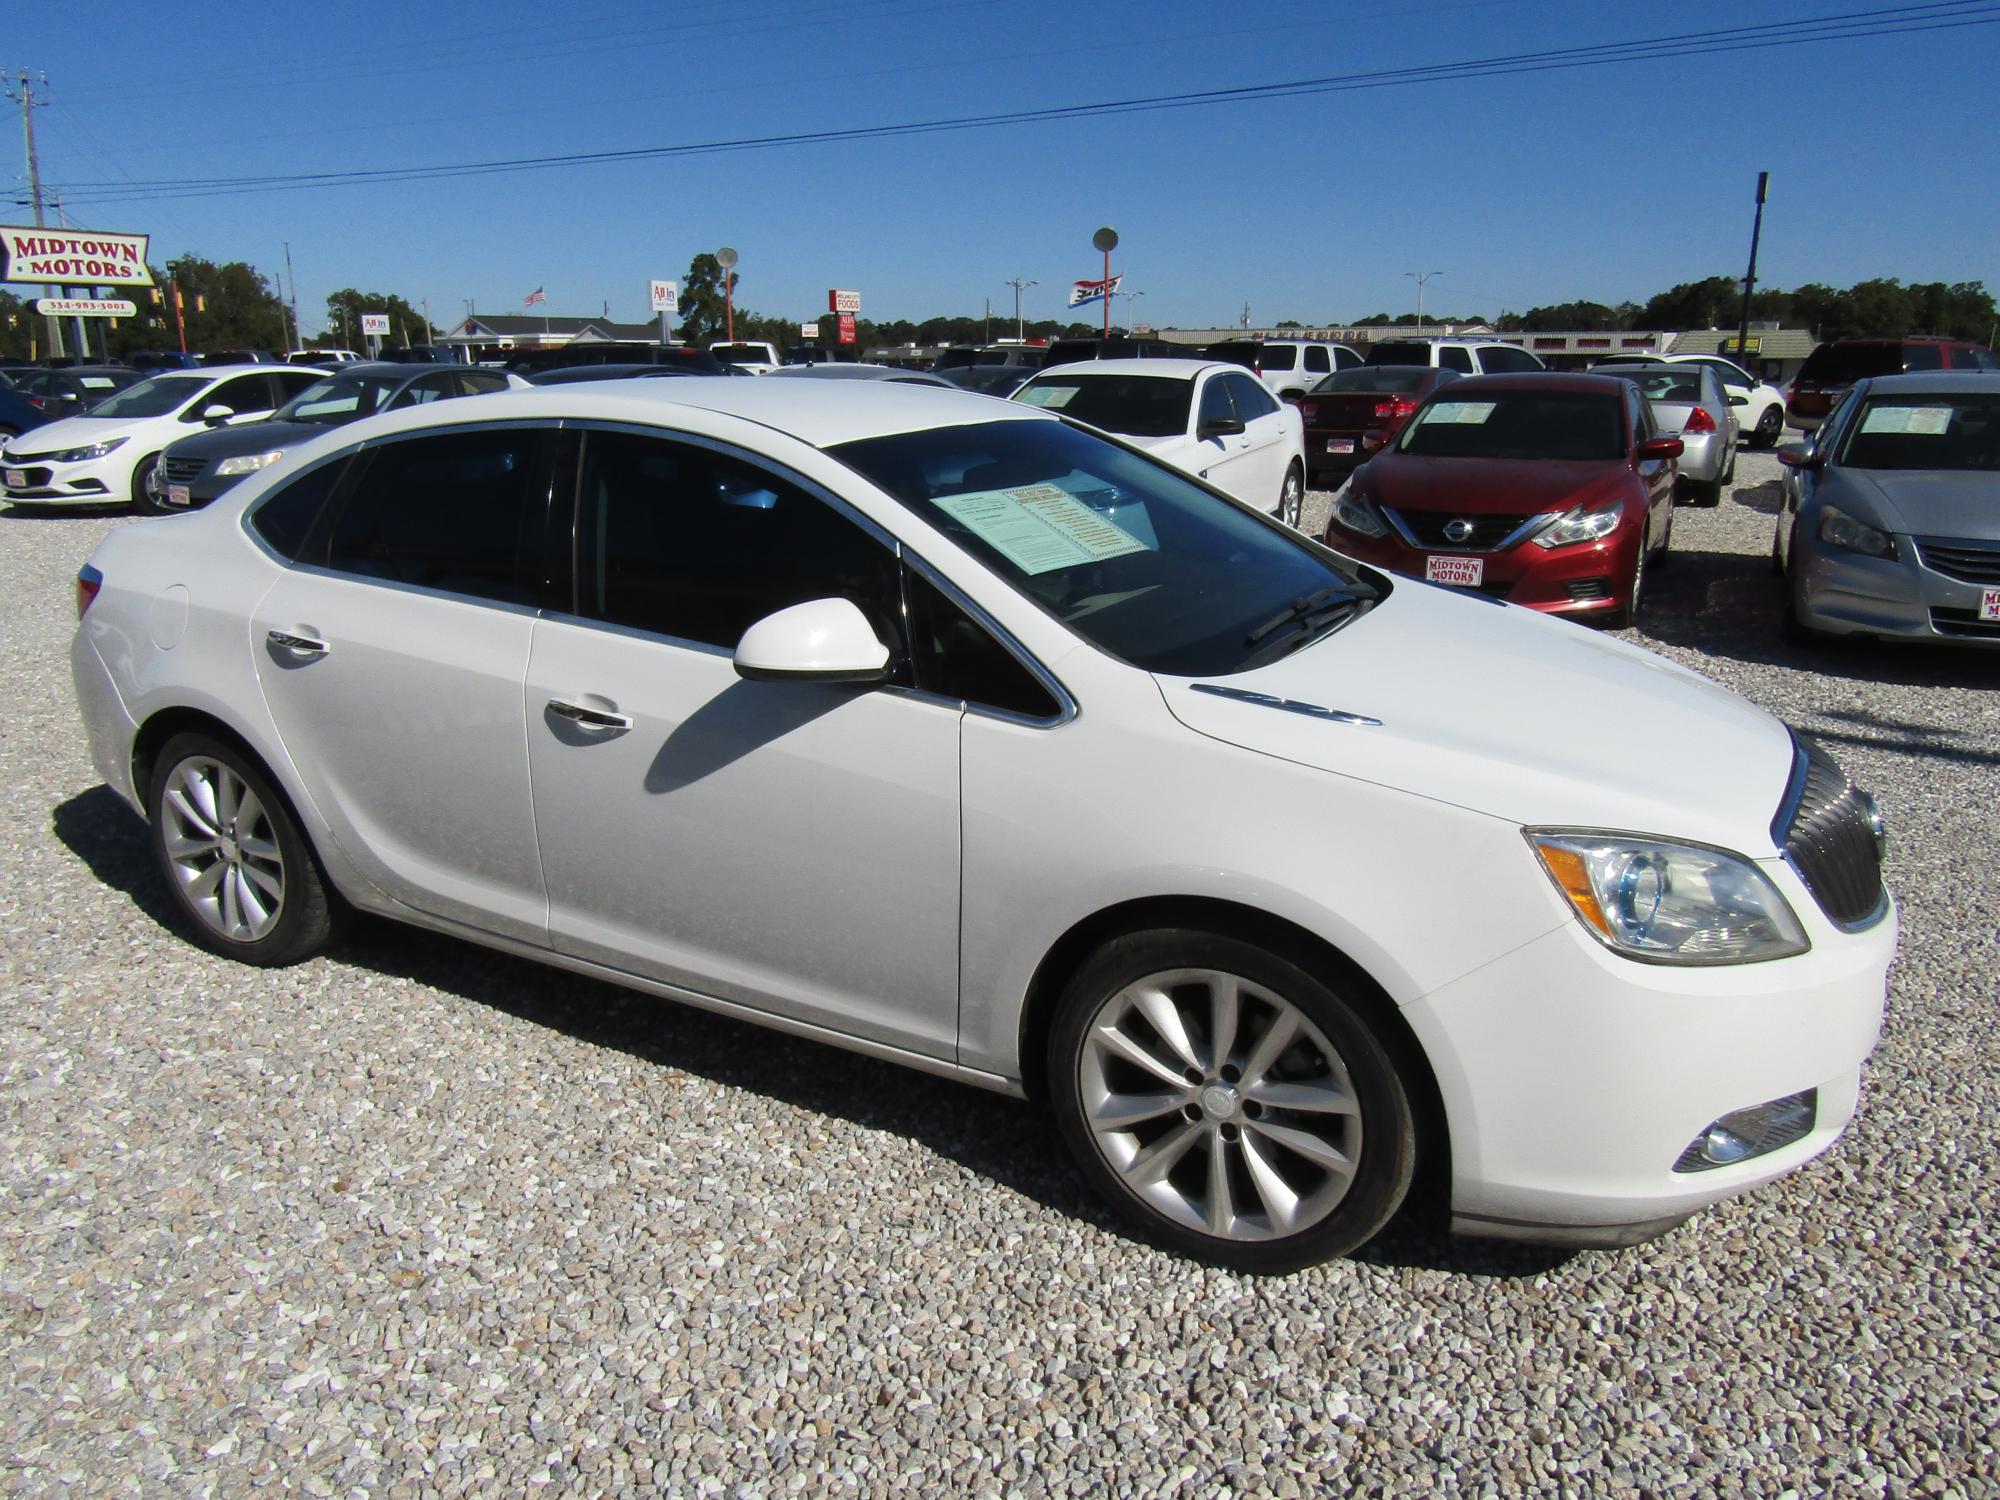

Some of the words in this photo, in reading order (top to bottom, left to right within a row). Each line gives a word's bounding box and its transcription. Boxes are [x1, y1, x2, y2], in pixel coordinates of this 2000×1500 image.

[14, 236, 138, 264] MIDTOWN
[31, 259, 132, 278] MOTORS
[838, 299, 859, 309] FOODS
[1430, 560, 1479, 574] MIDTOWN
[1432, 570, 1473, 582] MOTORS
